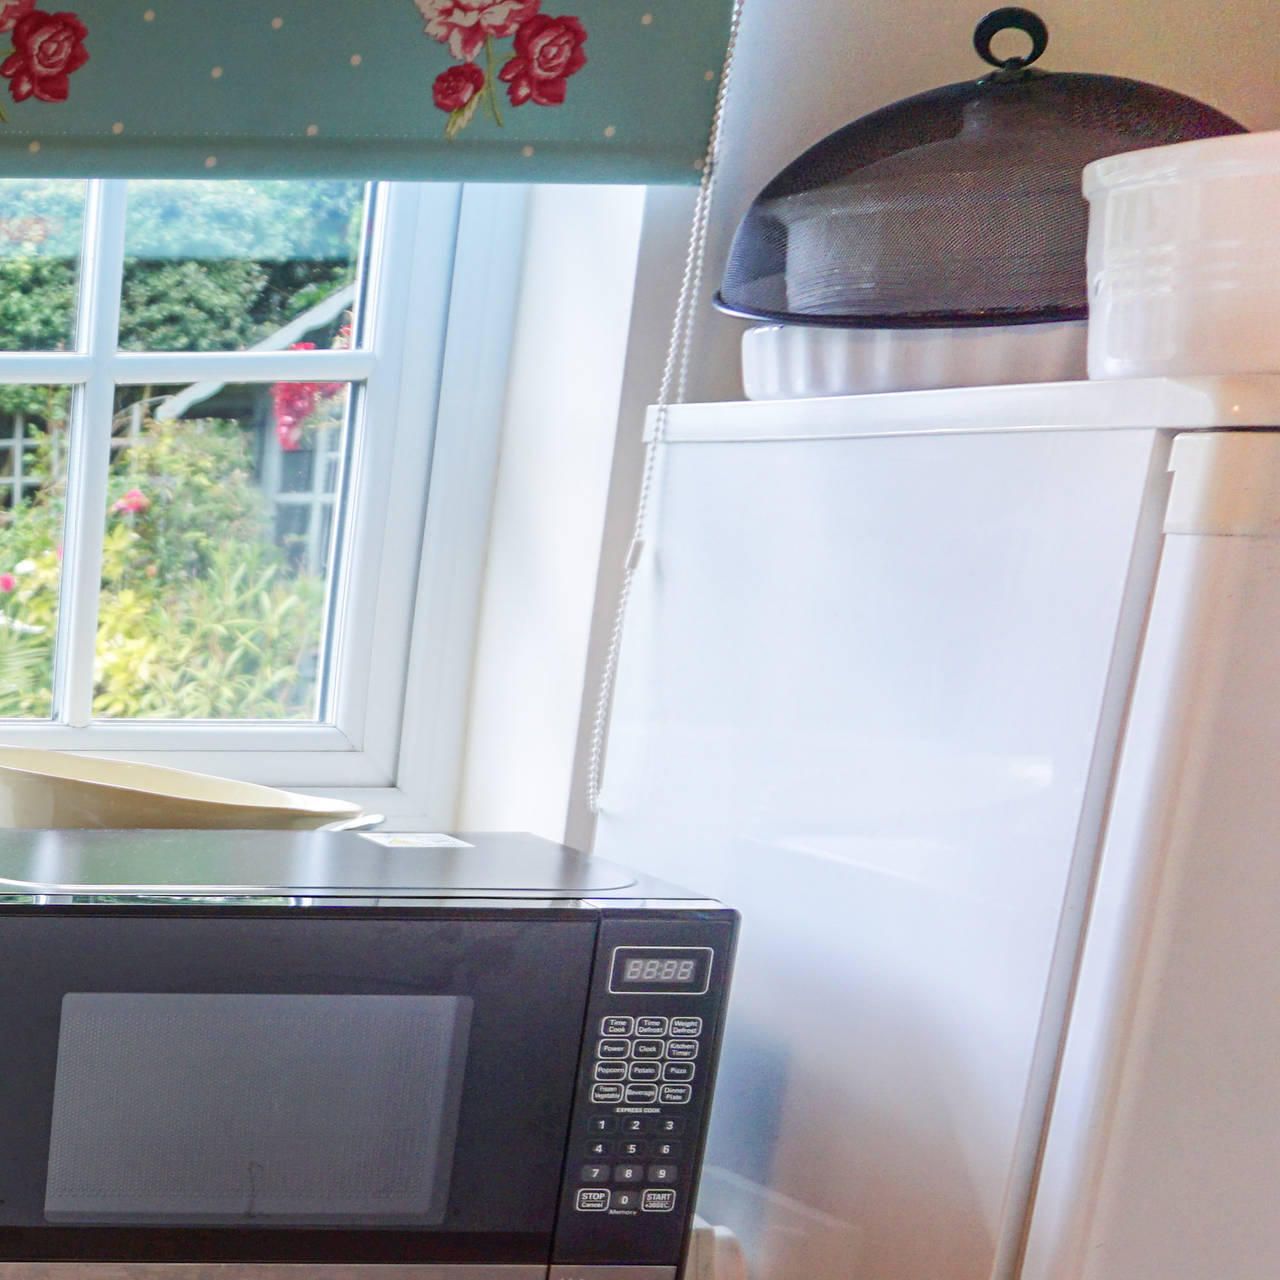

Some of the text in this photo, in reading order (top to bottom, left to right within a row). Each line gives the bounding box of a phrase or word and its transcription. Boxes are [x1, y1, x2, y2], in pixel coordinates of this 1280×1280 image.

[599, 1120, 605, 1129] 1
[632, 1121, 640, 1130] 2
[666, 1121, 674, 1130] 3
[595, 1144, 603, 1153] 4
[629, 1144, 637, 1153] 5
[662, 1145, 670, 1154] 6
[592, 1168, 600, 1178] 7
[625, 1169, 633, 1178] 8
[658, 1169, 666, 1178] 9
